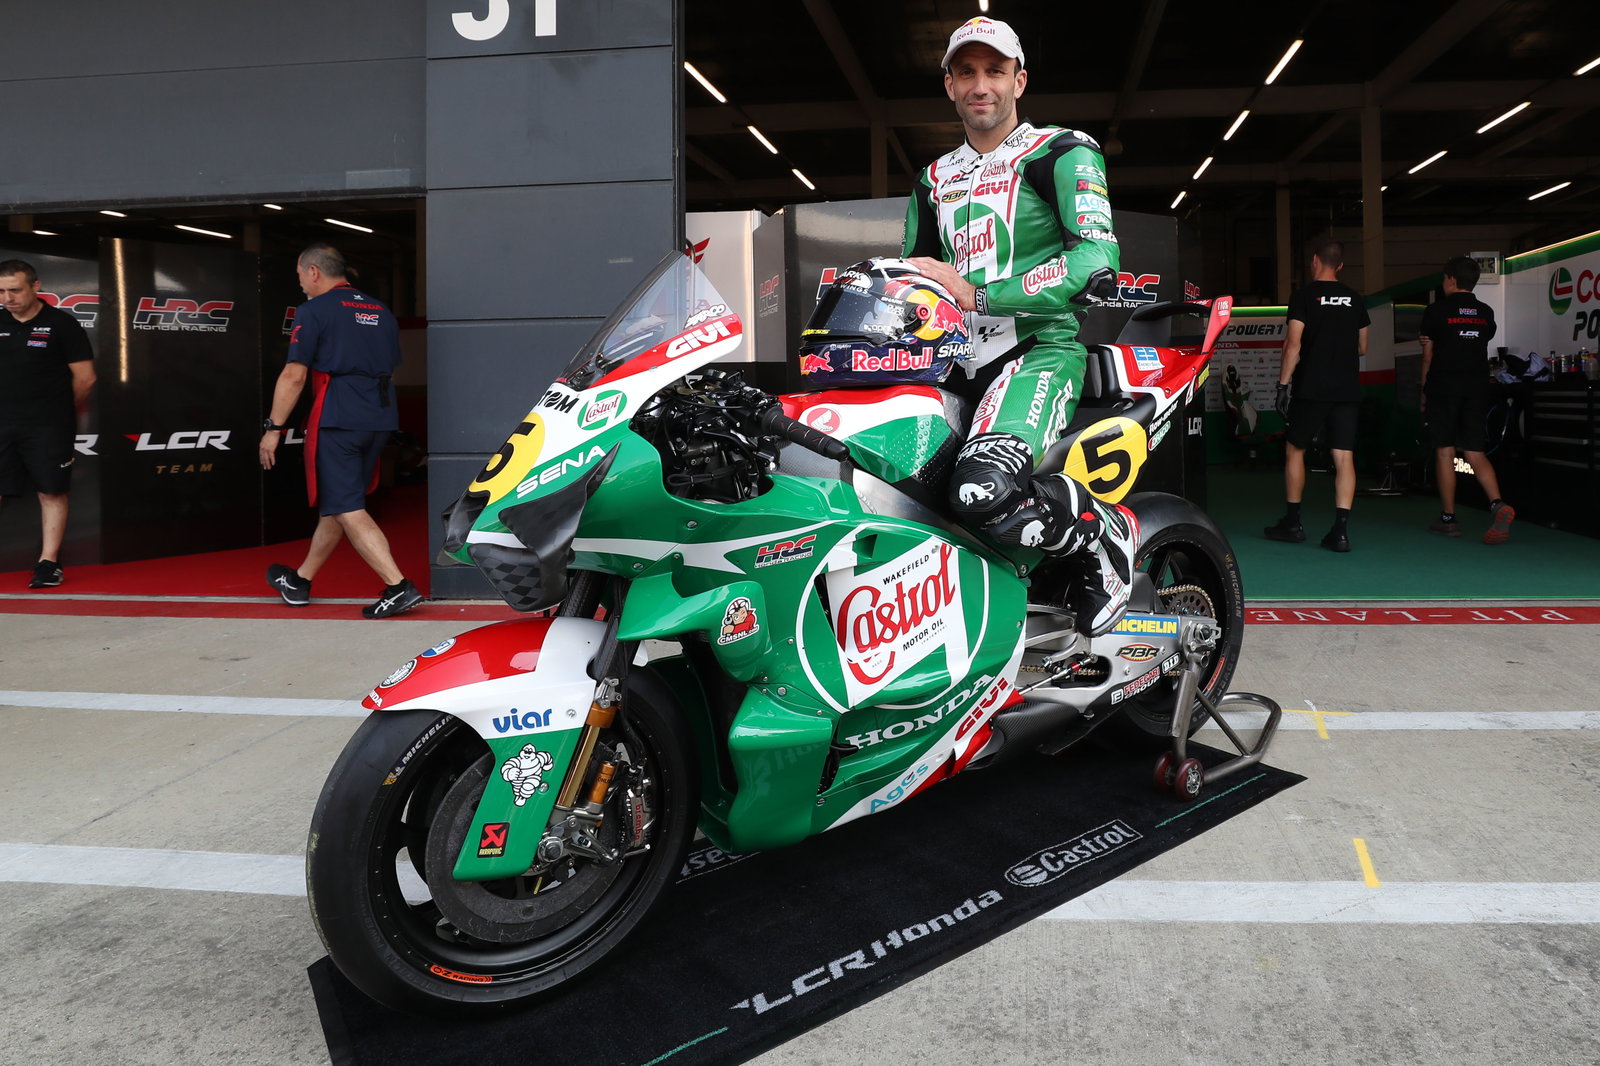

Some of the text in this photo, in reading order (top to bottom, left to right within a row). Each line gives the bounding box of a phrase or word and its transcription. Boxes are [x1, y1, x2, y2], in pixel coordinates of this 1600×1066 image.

[956, 27, 996, 42] Red Bull
[972, 180, 1009, 197] GIVI
[953, 217, 995, 273] Casrol
[1091, 229, 1119, 243] Beta
[1023, 255, 1067, 295] Castrol
[1108, 271, 1161, 303] RC
[133, 297, 234, 327] HRC
[341, 300, 384, 310] HONDA
[1320, 296, 1352, 307] LCR
[133, 323, 227, 333] Honda RACING
[355, 312, 380, 323] HRC
[1226, 324, 1283, 336] POWER1
[1447, 317, 1489, 325] HONDA
[666, 320, 731, 358] GIVI
[1458, 330, 1480, 338] LCR
[852, 346, 933, 372] Red Bull
[585, 394, 621, 423] Castrol
[1025, 370, 1054, 430] HONDA
[135, 430, 231, 451] LCR
[155, 463, 214, 475] TEAM
[515, 445, 607, 500] SENA
[1080, 424, 1131, 494] 5
[756, 534, 817, 563] HRC
[882, 554, 930, 586] WAKEFIELD
[836, 542, 956, 686] Castrol
[902, 617, 945, 652] MOTOR OIL
[1115, 647, 1160, 658] PBR
[1124, 675, 1161, 700] GROUP
[492, 707, 554, 734] viar
[845, 674, 996, 750] HONDA
[954, 677, 1009, 742] GIVI
[402, 714, 454, 765] MICHELIN
[1043, 823, 1136, 875] Castrol
[751, 888, 1004, 1015] LCR Honda
[453, 974, 484, 982] RACING
